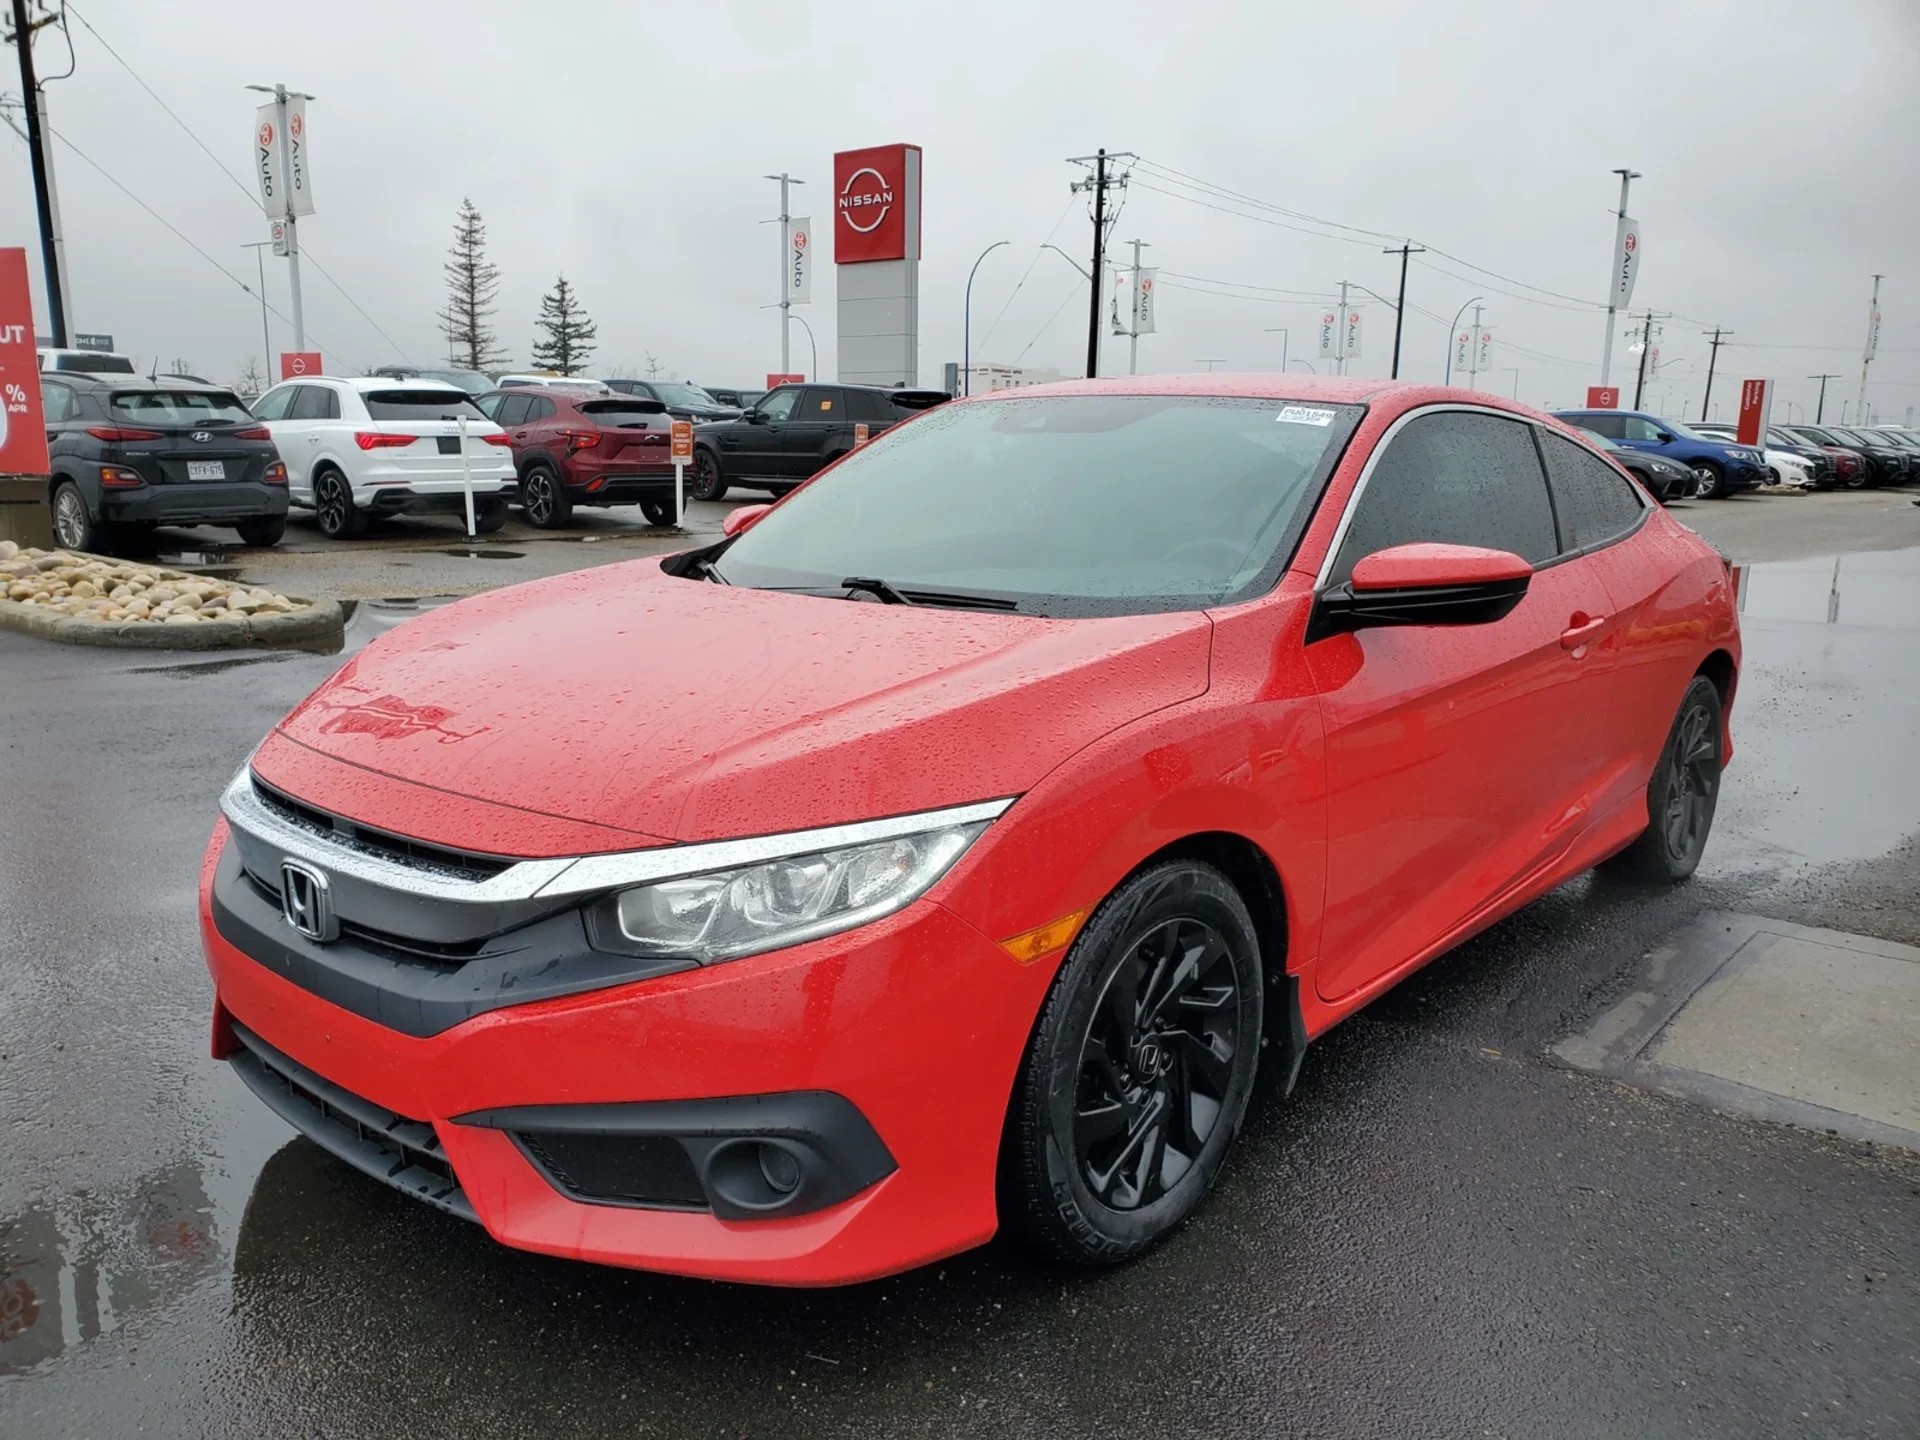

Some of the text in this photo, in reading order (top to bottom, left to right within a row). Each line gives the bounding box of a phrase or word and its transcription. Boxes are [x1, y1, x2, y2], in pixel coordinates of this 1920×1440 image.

[259, 123, 273, 198] go Auto
[290, 113, 302, 190] go Auto
[839, 191, 893, 208] NISSAN
[794, 250, 803, 288] Auto
[1620, 252, 1632, 292] Auto
[1140, 292, 1149, 321] Auto
[1322, 325, 1331, 348] Auto
[1348, 324, 1356, 348] Auto
[1480, 342, 1488, 363] Auto
[1743, 382, 1753, 411] Customer
[1753, 381, 1761, 405] Parking
[8, 404, 28, 413] APR
